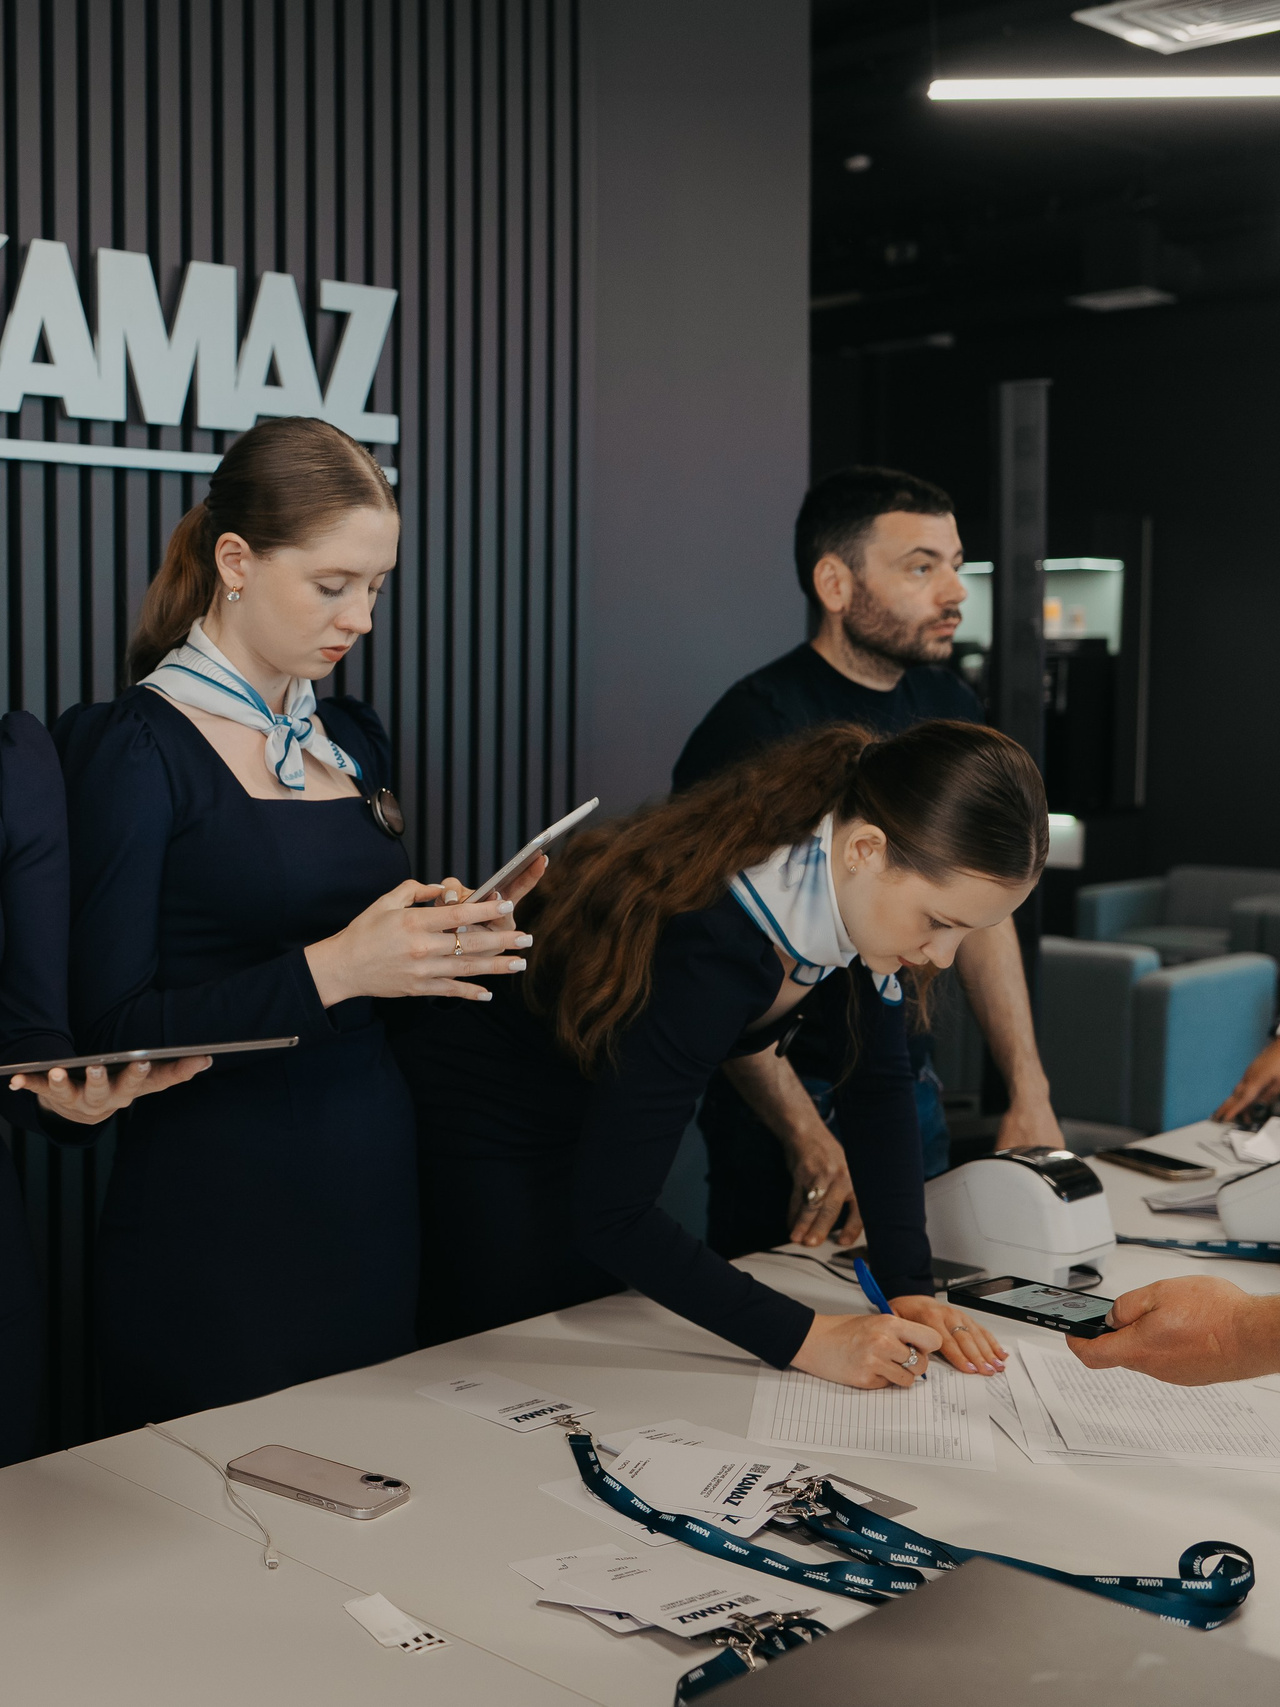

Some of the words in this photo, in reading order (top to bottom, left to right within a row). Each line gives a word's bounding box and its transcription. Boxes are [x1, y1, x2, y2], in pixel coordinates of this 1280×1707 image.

[602, 1475, 622, 1492] KAMAZ
[722, 1473, 762, 1507] KAMAZ
[630, 1497, 652, 1514] KAMAZ
[685, 1521, 711, 1538] KAMAZ
[861, 1526, 888, 1543] KAMAZ
[723, 1540, 750, 1556] KAMAZ
[904, 1542, 933, 1557] KAMAZ
[763, 1557, 790, 1571] KAMAZ
[890, 1553, 919, 1565] KAMAZ
[845, 1573, 874, 1587] KAMAZ
[890, 1581, 918, 1591] KAMAZ
[1136, 1578, 1164, 1587] KAMAZ
[1181, 1580, 1213, 1590] KAMAZ
[672, 1601, 741, 1624] KAMAZ
[1159, 1614, 1191, 1630] KAMAZ
